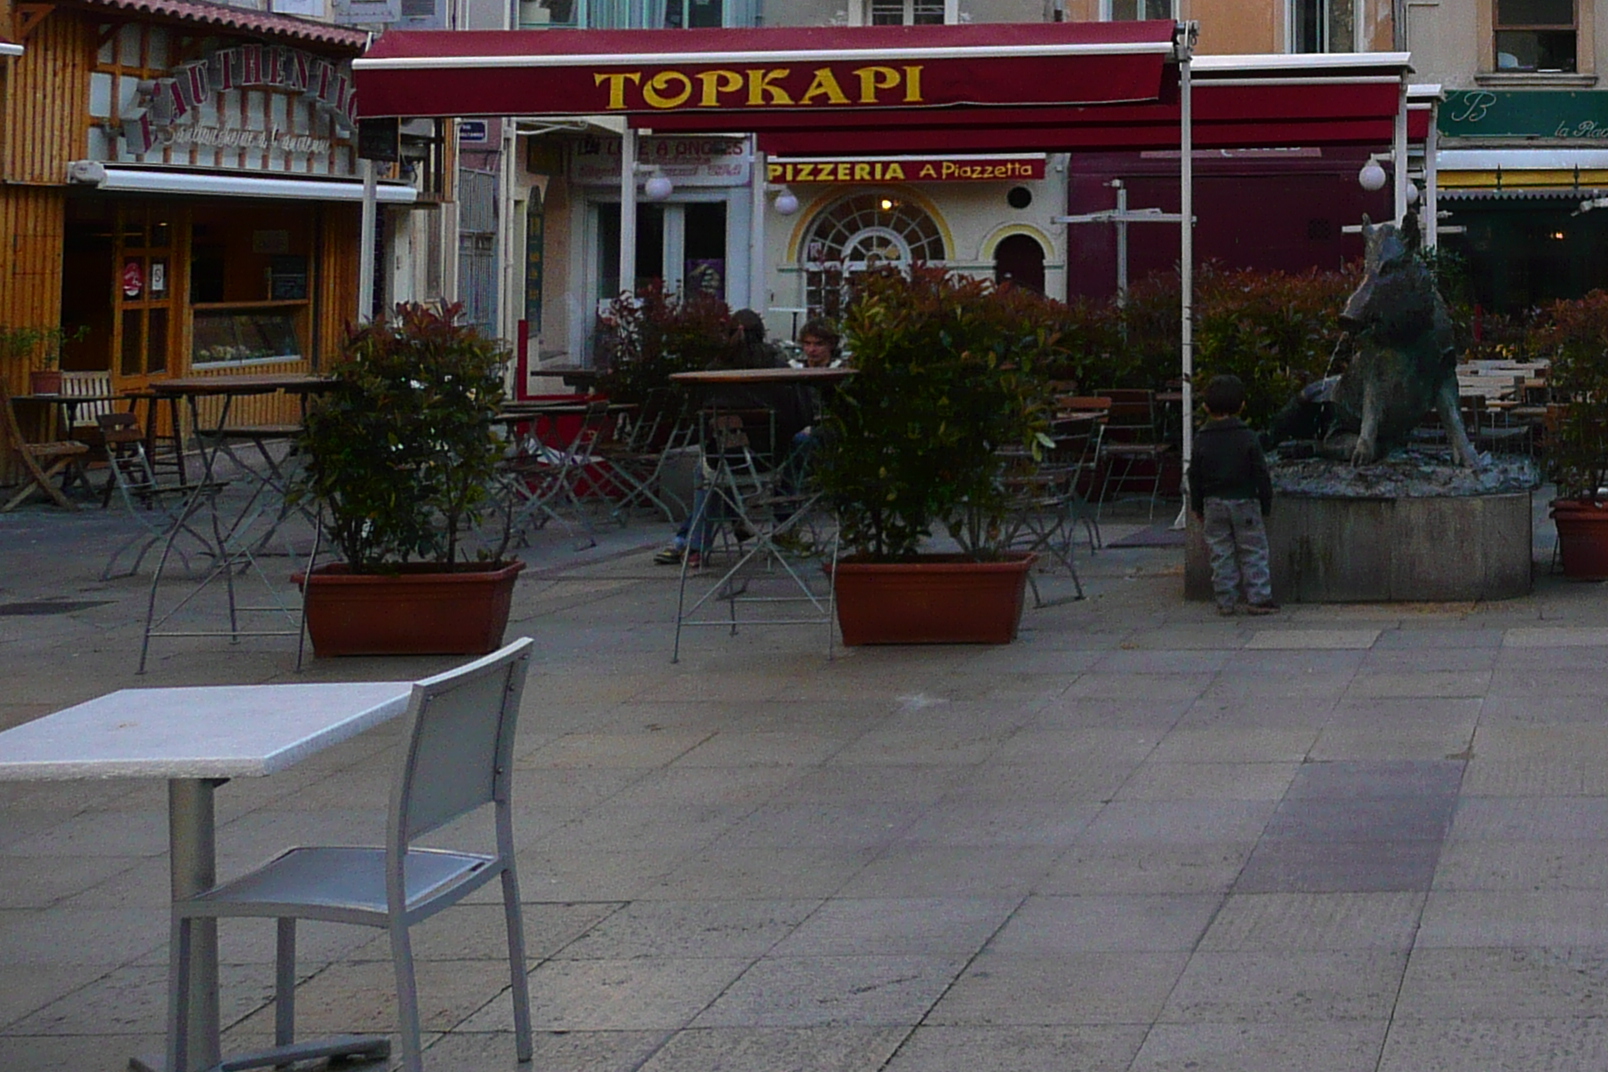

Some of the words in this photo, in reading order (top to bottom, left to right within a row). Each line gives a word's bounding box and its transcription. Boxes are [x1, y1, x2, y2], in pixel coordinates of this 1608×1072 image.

[594, 65, 924, 110] TOPKAPI
[676, 139, 743, 156] ONGES
[767, 163, 905, 181] PIZZERIA
[919, 164, 938, 178] A
[942, 161, 1032, 180] Piazzetta
